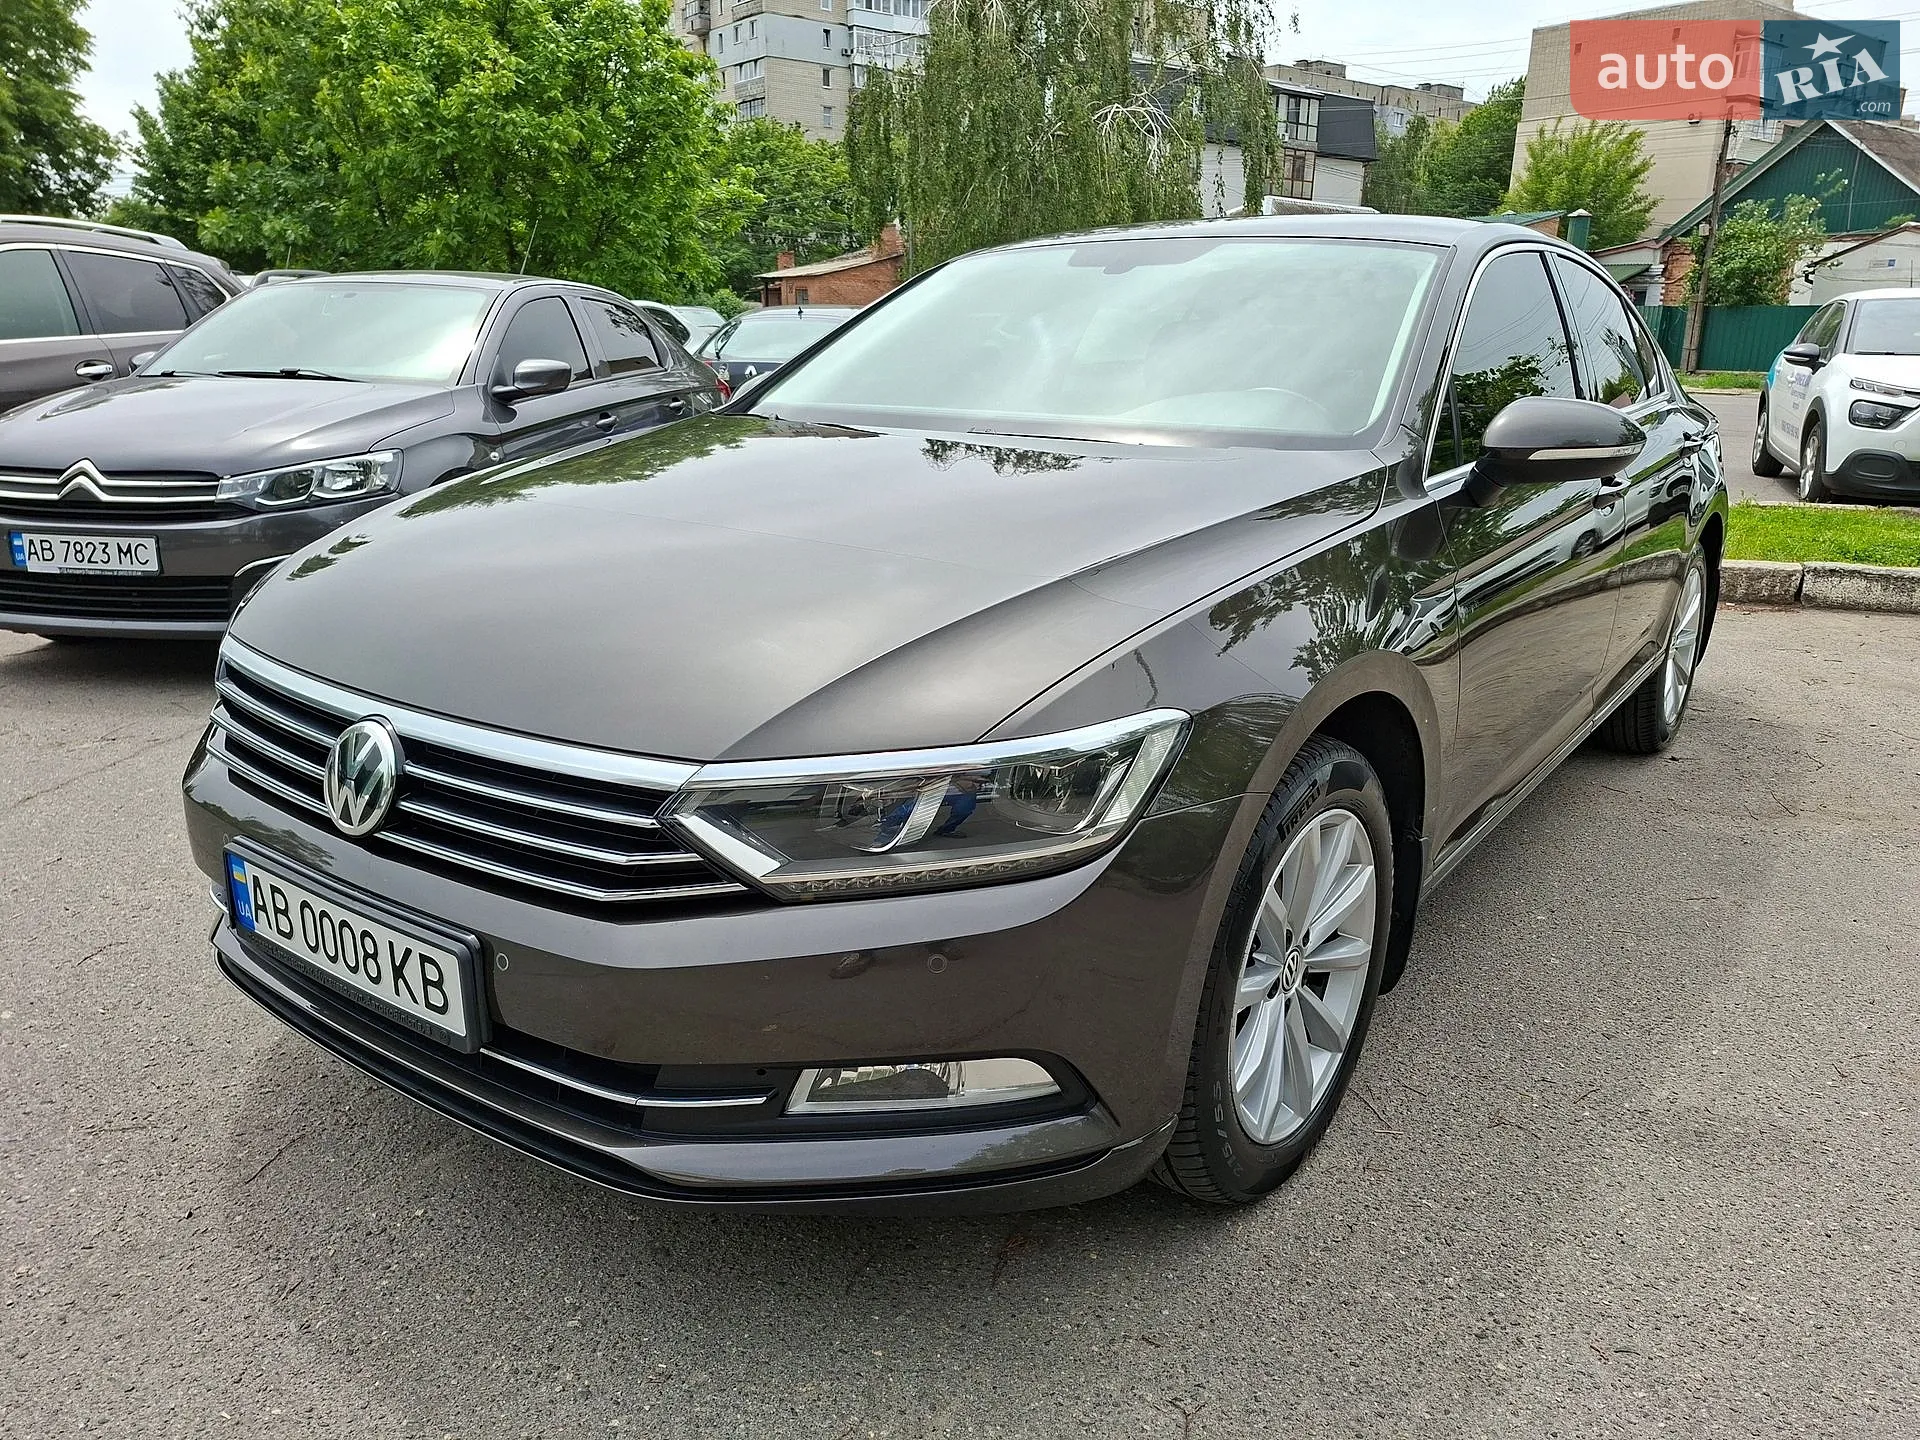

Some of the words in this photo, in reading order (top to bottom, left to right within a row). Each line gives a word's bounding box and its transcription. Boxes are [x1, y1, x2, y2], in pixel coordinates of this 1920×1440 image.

[15, 553, 25, 561] UA
[28, 539, 56, 561] AB
[60, 540, 111, 565] 7823
[117, 542, 150, 566] MC
[237, 900, 253, 920] UA
[252, 873, 294, 941] AB
[300, 899, 382, 986] 0008
[387, 939, 450, 1016] KB
